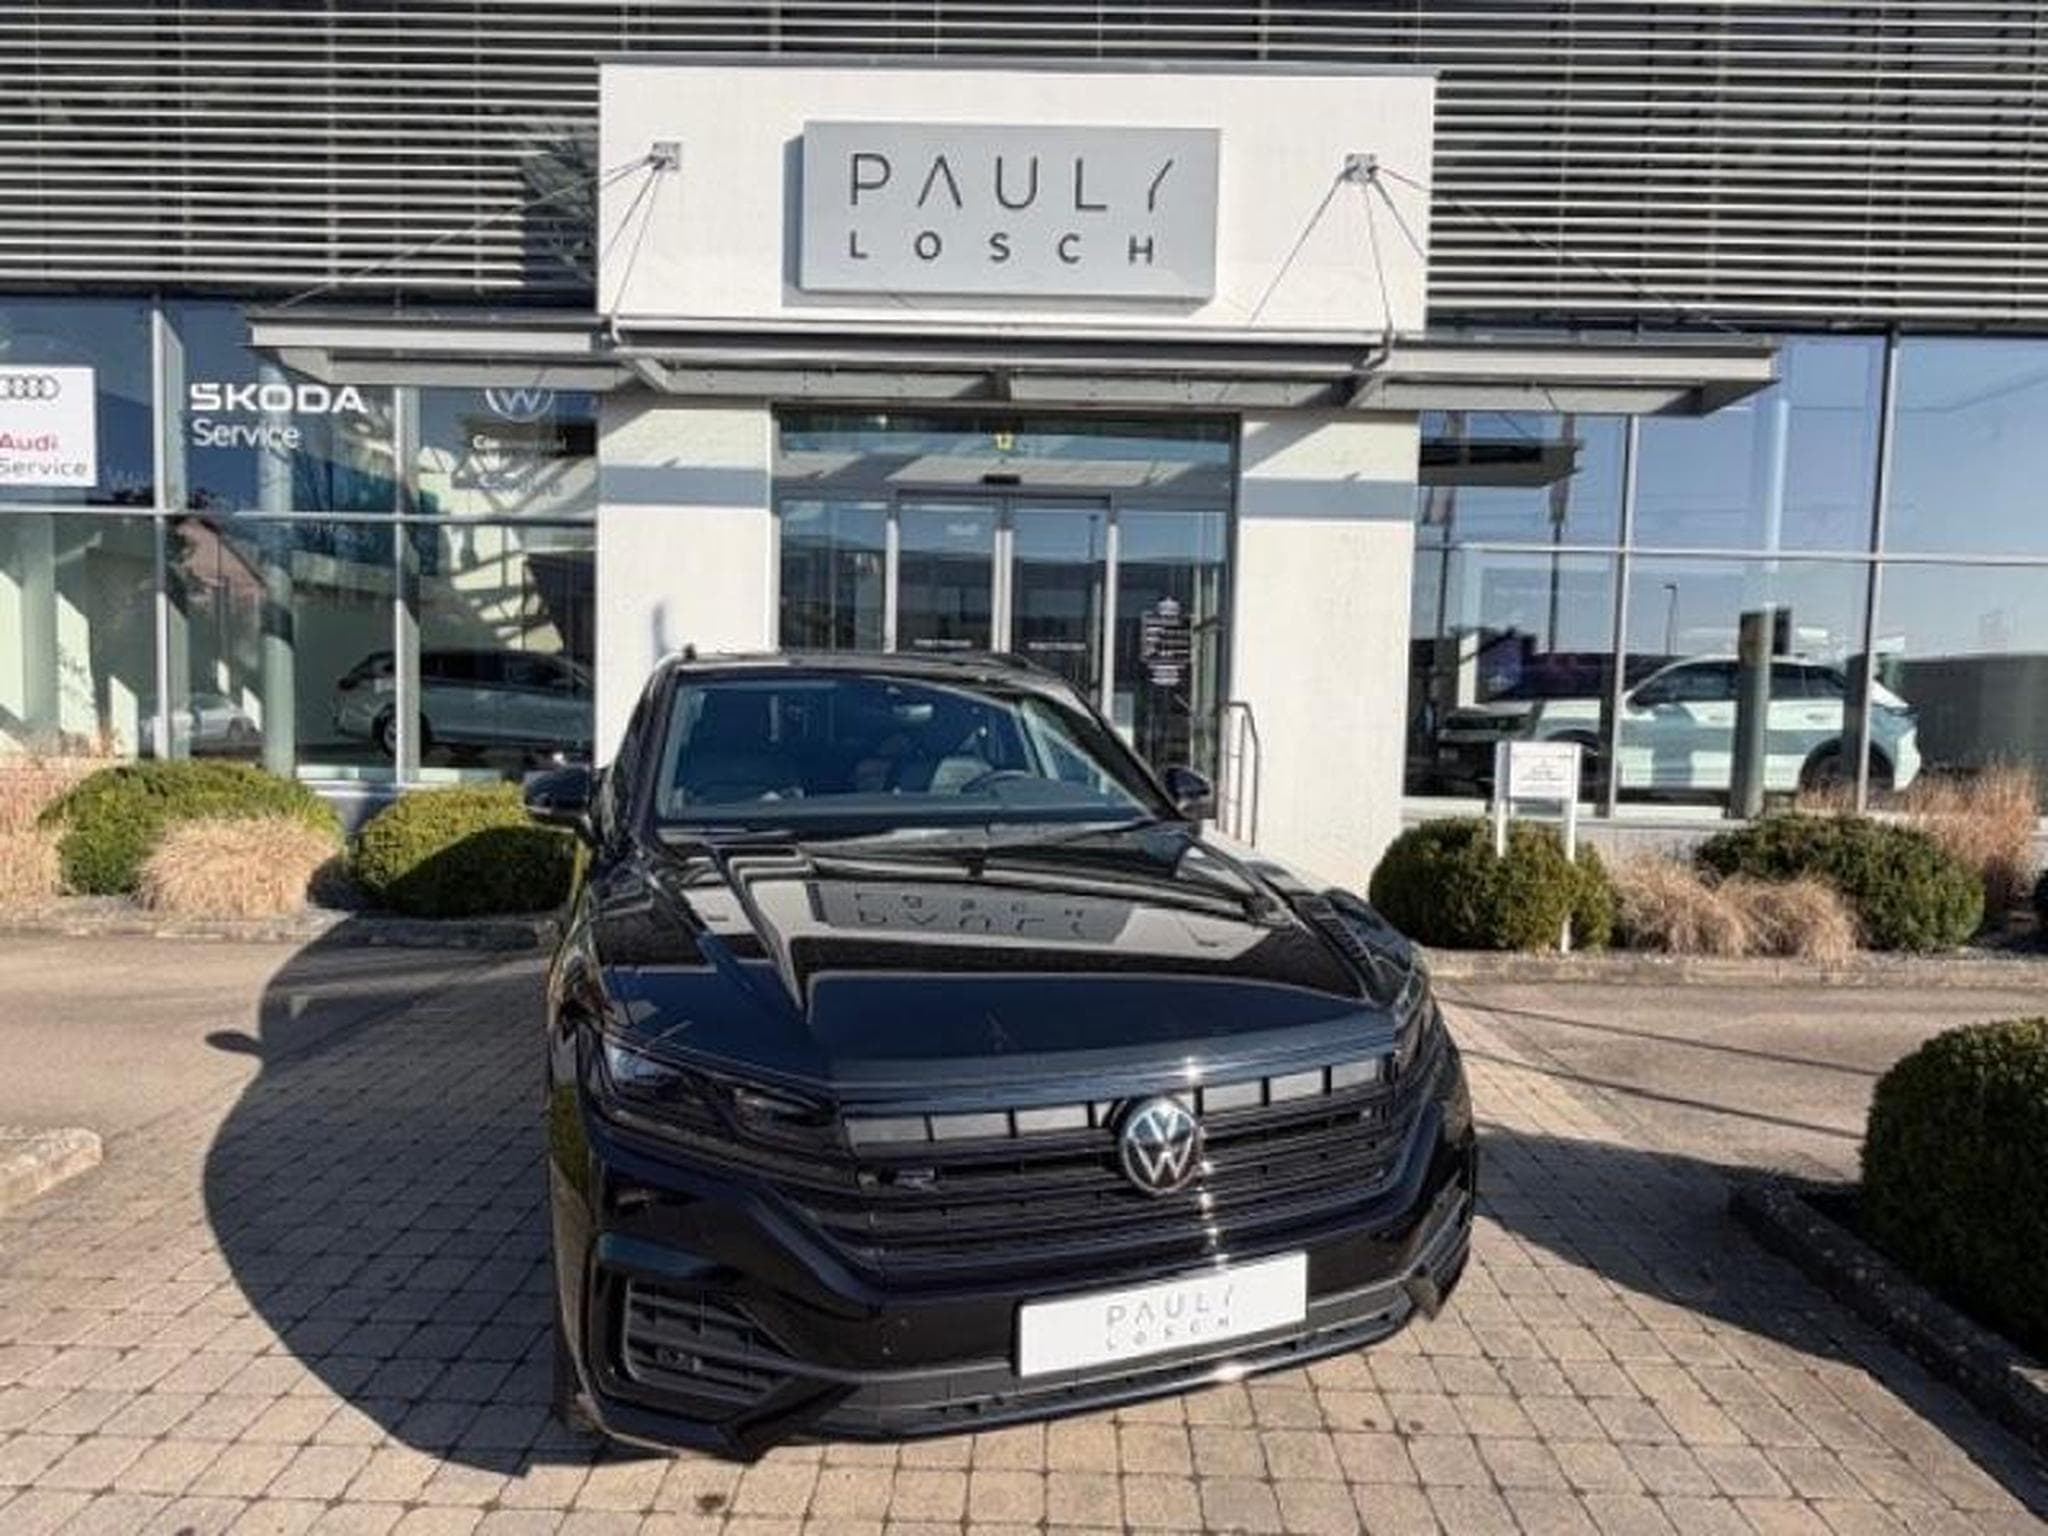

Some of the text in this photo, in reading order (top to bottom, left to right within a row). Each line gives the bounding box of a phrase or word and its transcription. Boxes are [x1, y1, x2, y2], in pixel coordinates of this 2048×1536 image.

[850, 152, 1174, 212] PAULY
[850, 230, 1154, 264] LOSCH
[0, 433, 58, 451] Audi
[192, 418, 301, 449] Service
[0, 458, 87, 476] Service
[1106, 1284, 1233, 1328] PAULY
